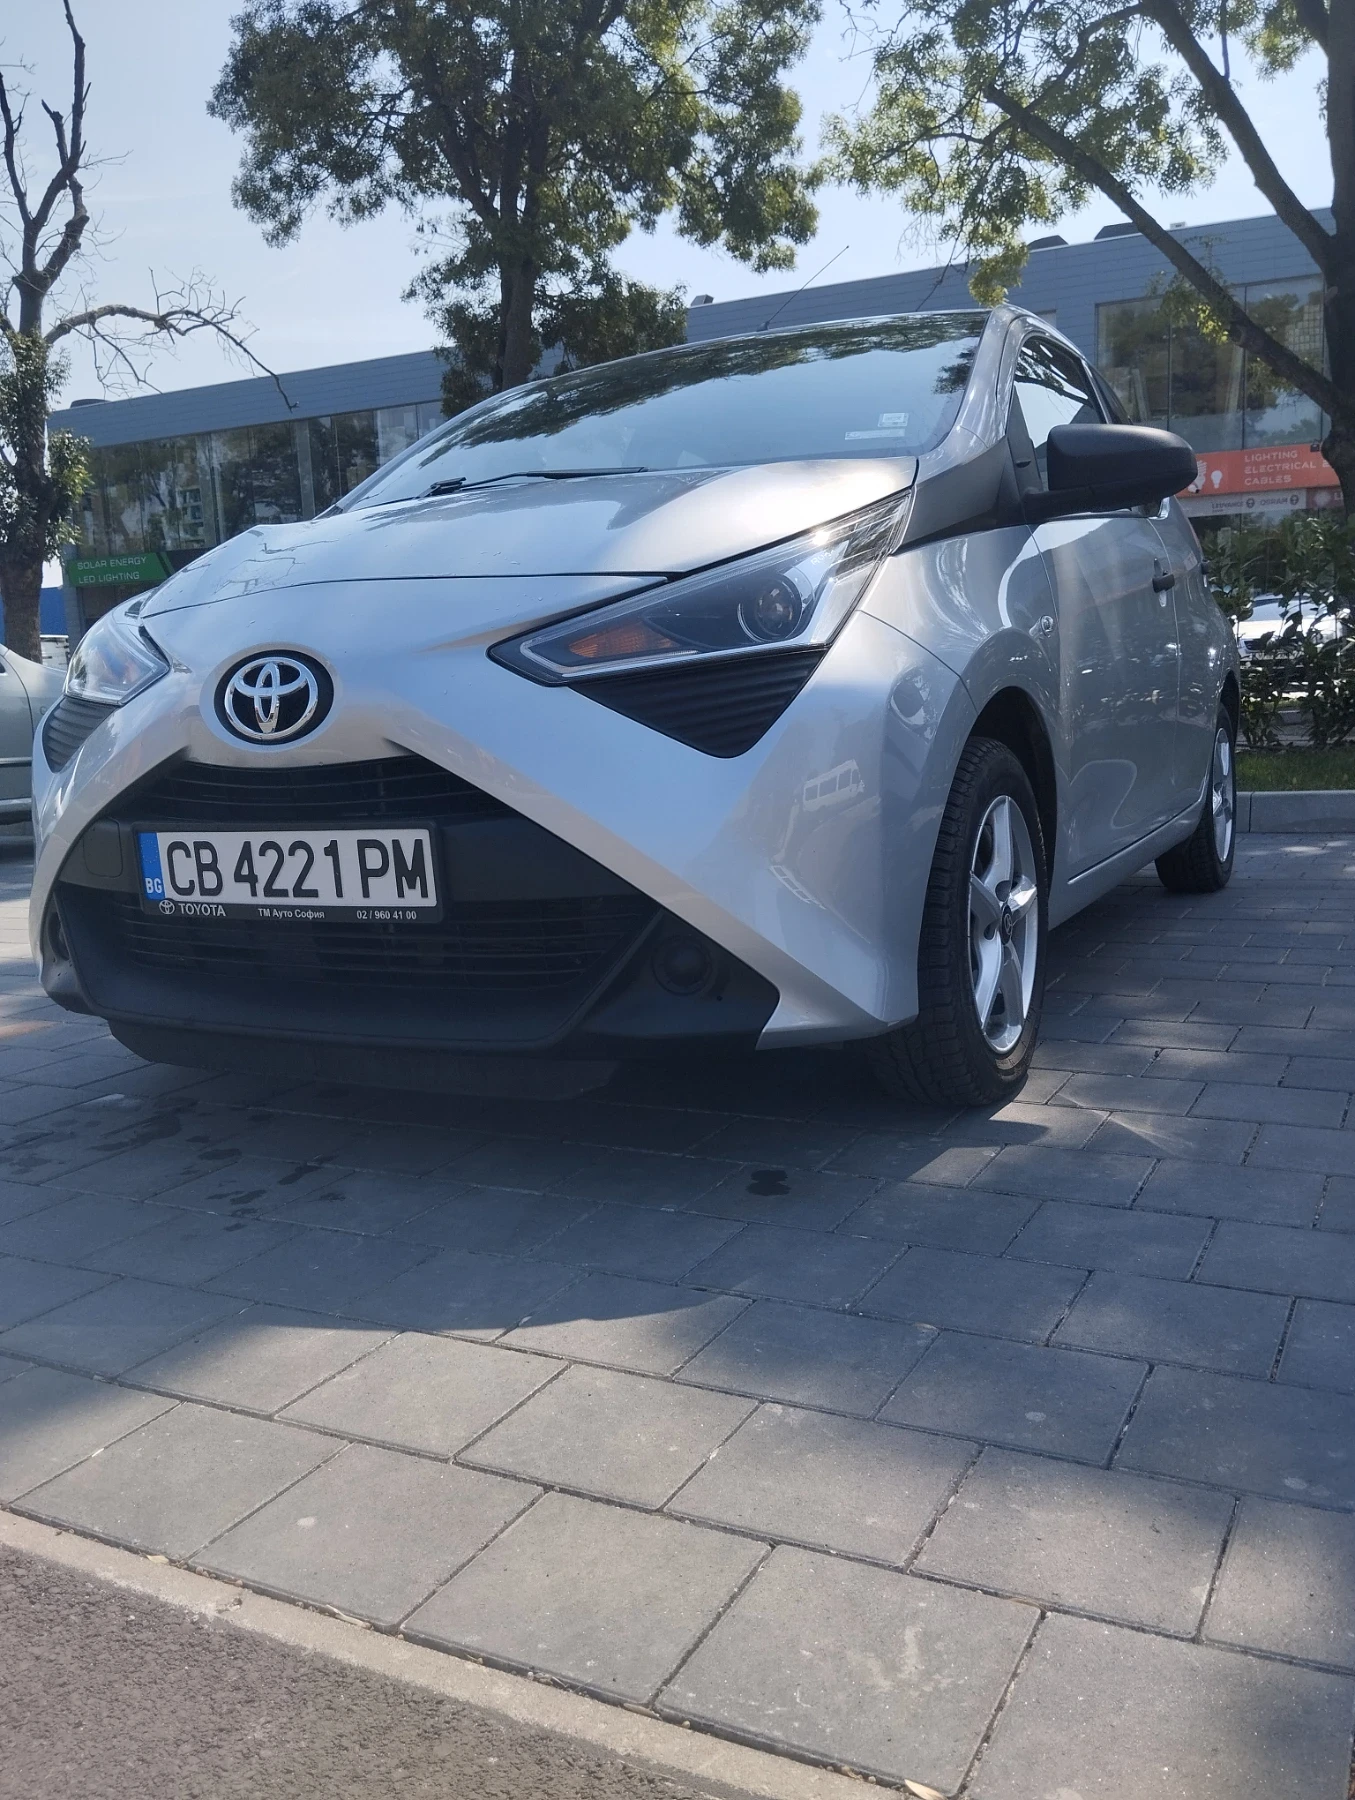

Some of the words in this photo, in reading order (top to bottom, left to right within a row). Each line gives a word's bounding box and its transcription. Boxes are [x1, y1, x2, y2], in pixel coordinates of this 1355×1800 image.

[1244, 450, 1298, 463] LIGHTING
[1244, 461, 1317, 475] ELECTRICAL
[1244, 474, 1292, 486] CABLES
[77, 561, 108, 571] SOLAR
[110, 556, 147, 568] ENERGY
[78, 575, 96, 584] LED
[98, 571, 140, 582] LIGHTING
[166, 840, 224, 897] CB
[233, 839, 344, 898] 4221
[356, 838, 429, 899] PM
[145, 877, 163, 894] BG
[178, 902, 227, 917] TOYOTA
[294, 908, 325, 919] София
[356, 910, 368, 919] 02
[374, 910, 391, 920] 960
[392, 910, 403, 920] 41
[405, 910, 417, 920] 00
